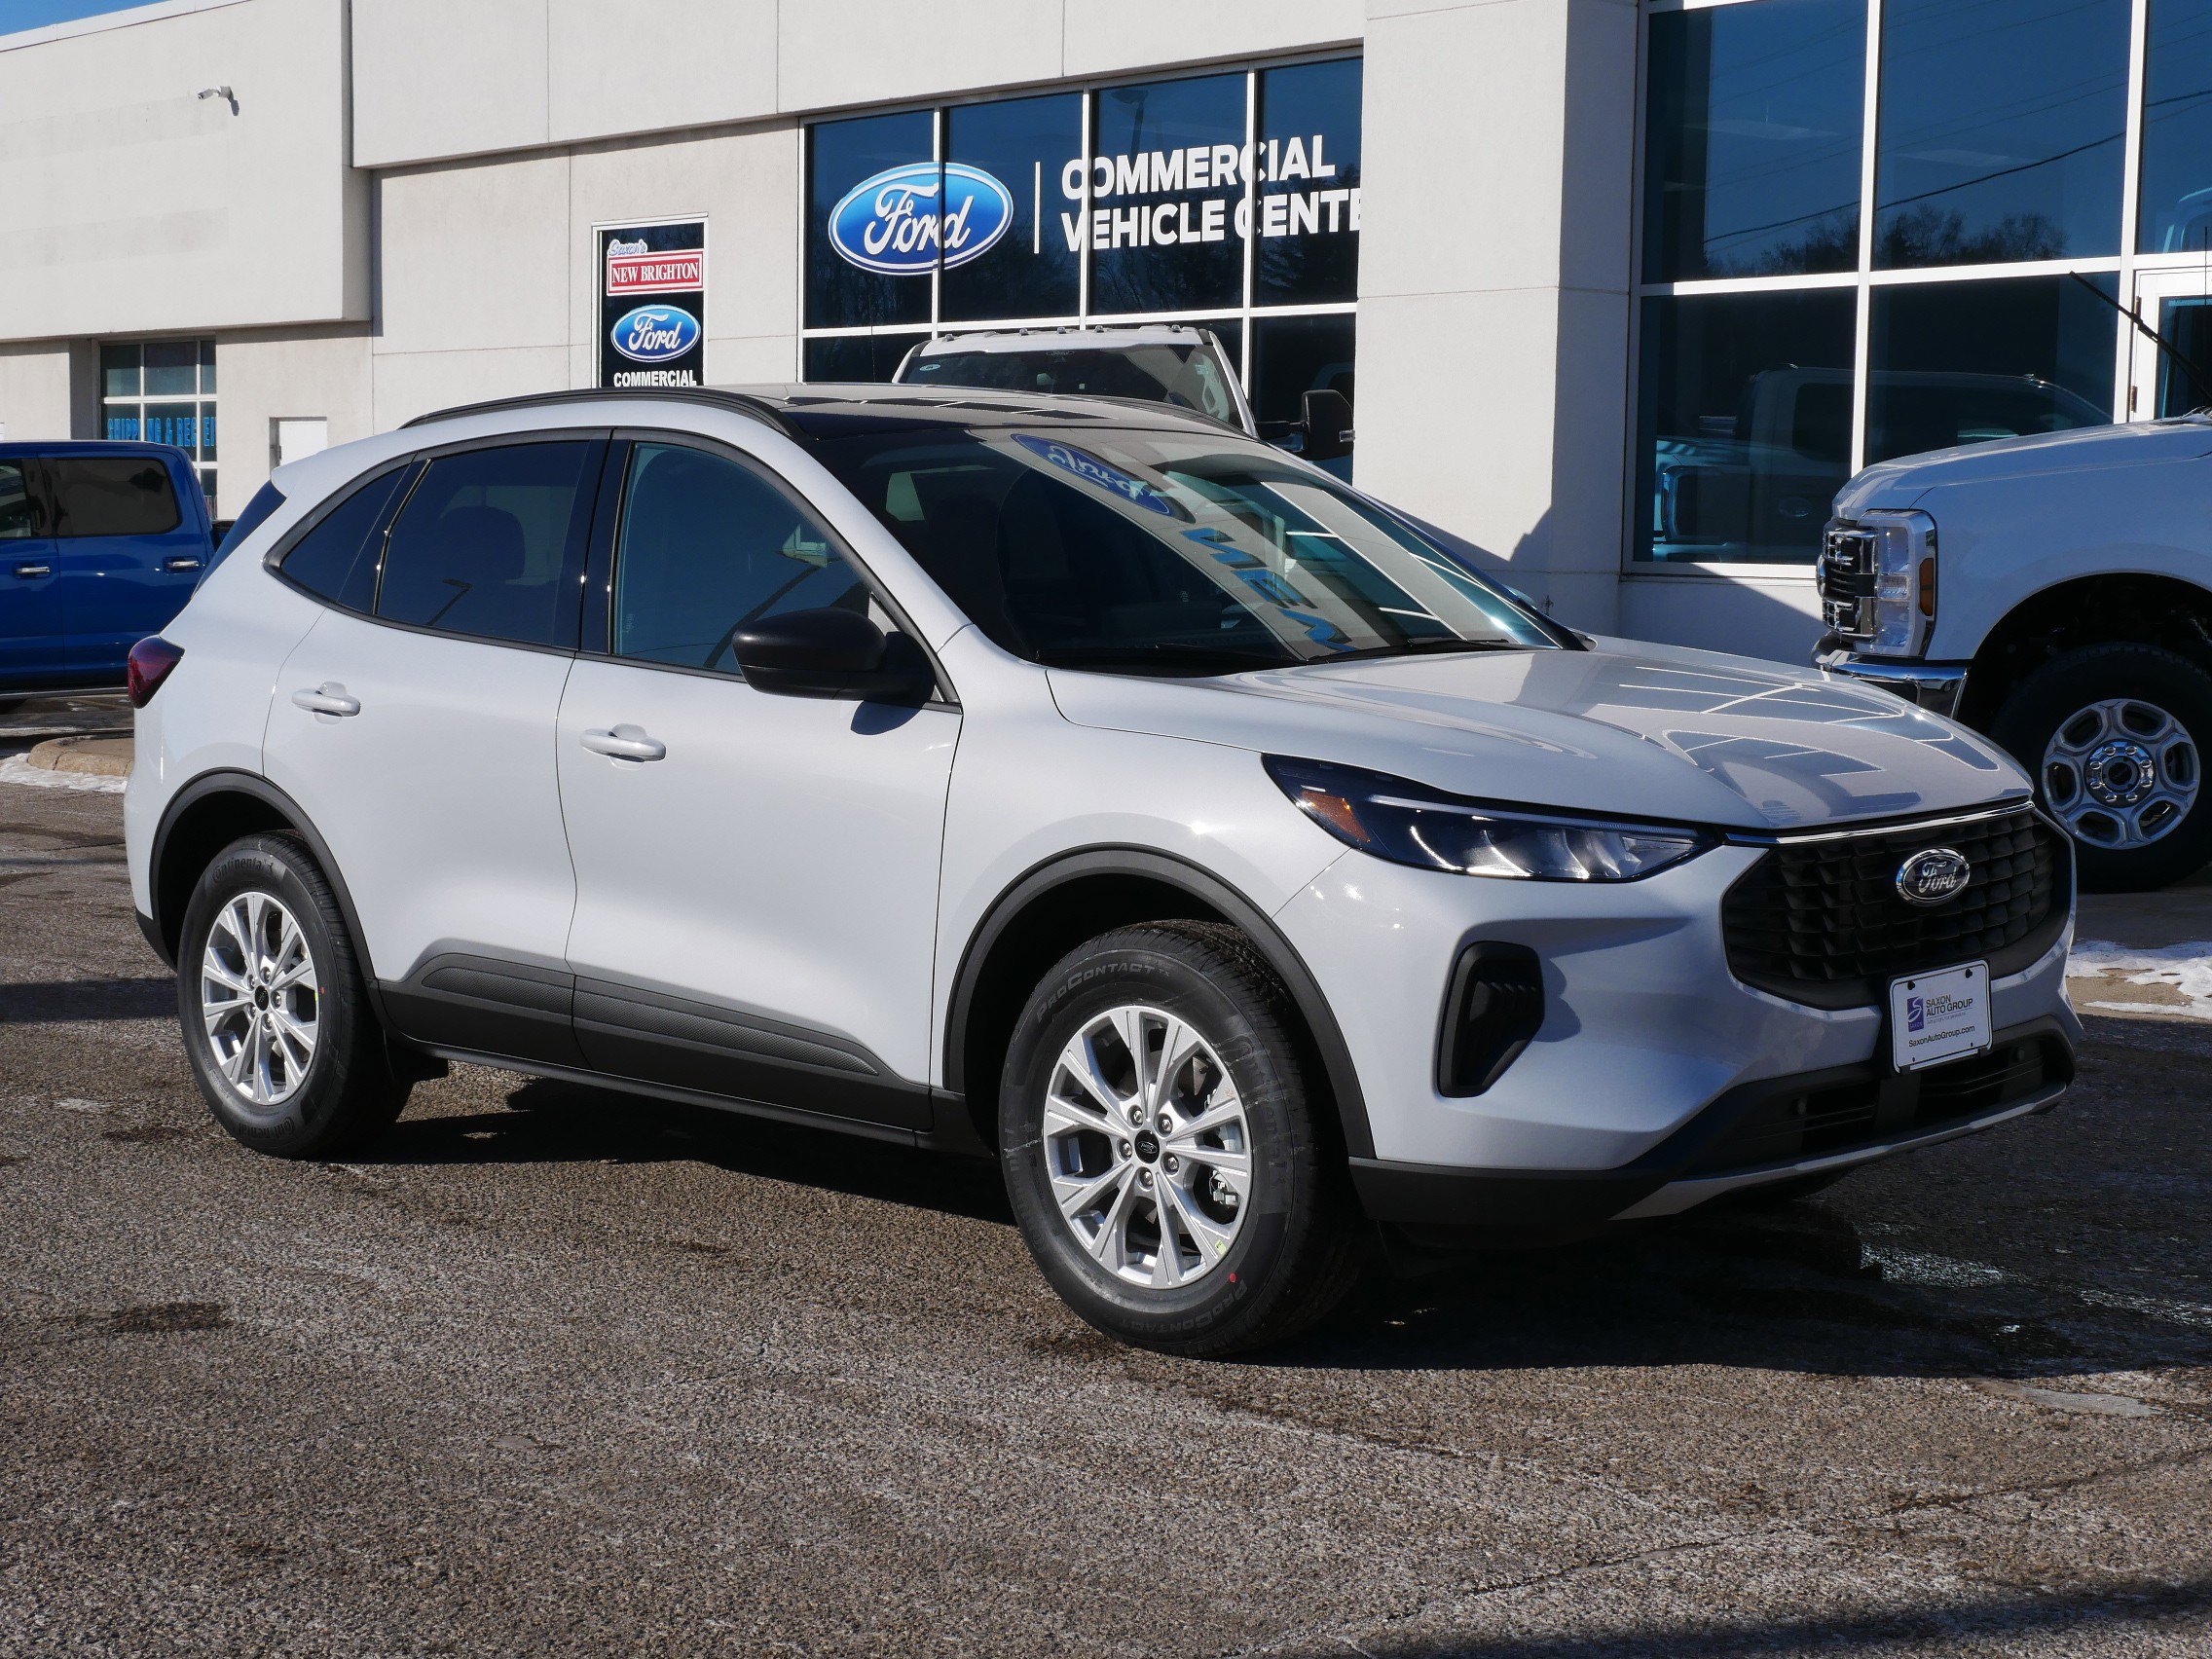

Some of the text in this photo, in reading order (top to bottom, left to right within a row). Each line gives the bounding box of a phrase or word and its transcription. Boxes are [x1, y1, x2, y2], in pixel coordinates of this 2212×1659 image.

[1062, 135, 1335, 200] COMMERCIAL
[865, 182, 974, 255] Ford
[1061, 200, 1225, 251] VEHICLE
[611, 262, 698, 283] NEW BRIGHTON
[628, 313, 682, 350] Ford
[613, 369, 697, 387] COMMERCIAL
[1918, 861, 1957, 893] Ford
[1926, 994, 1951, 1009] SAXON
[1927, 998, 1973, 1017] AUTO GROUP
[1909, 1025, 1975, 1048] SaxonAutoGroup.com
